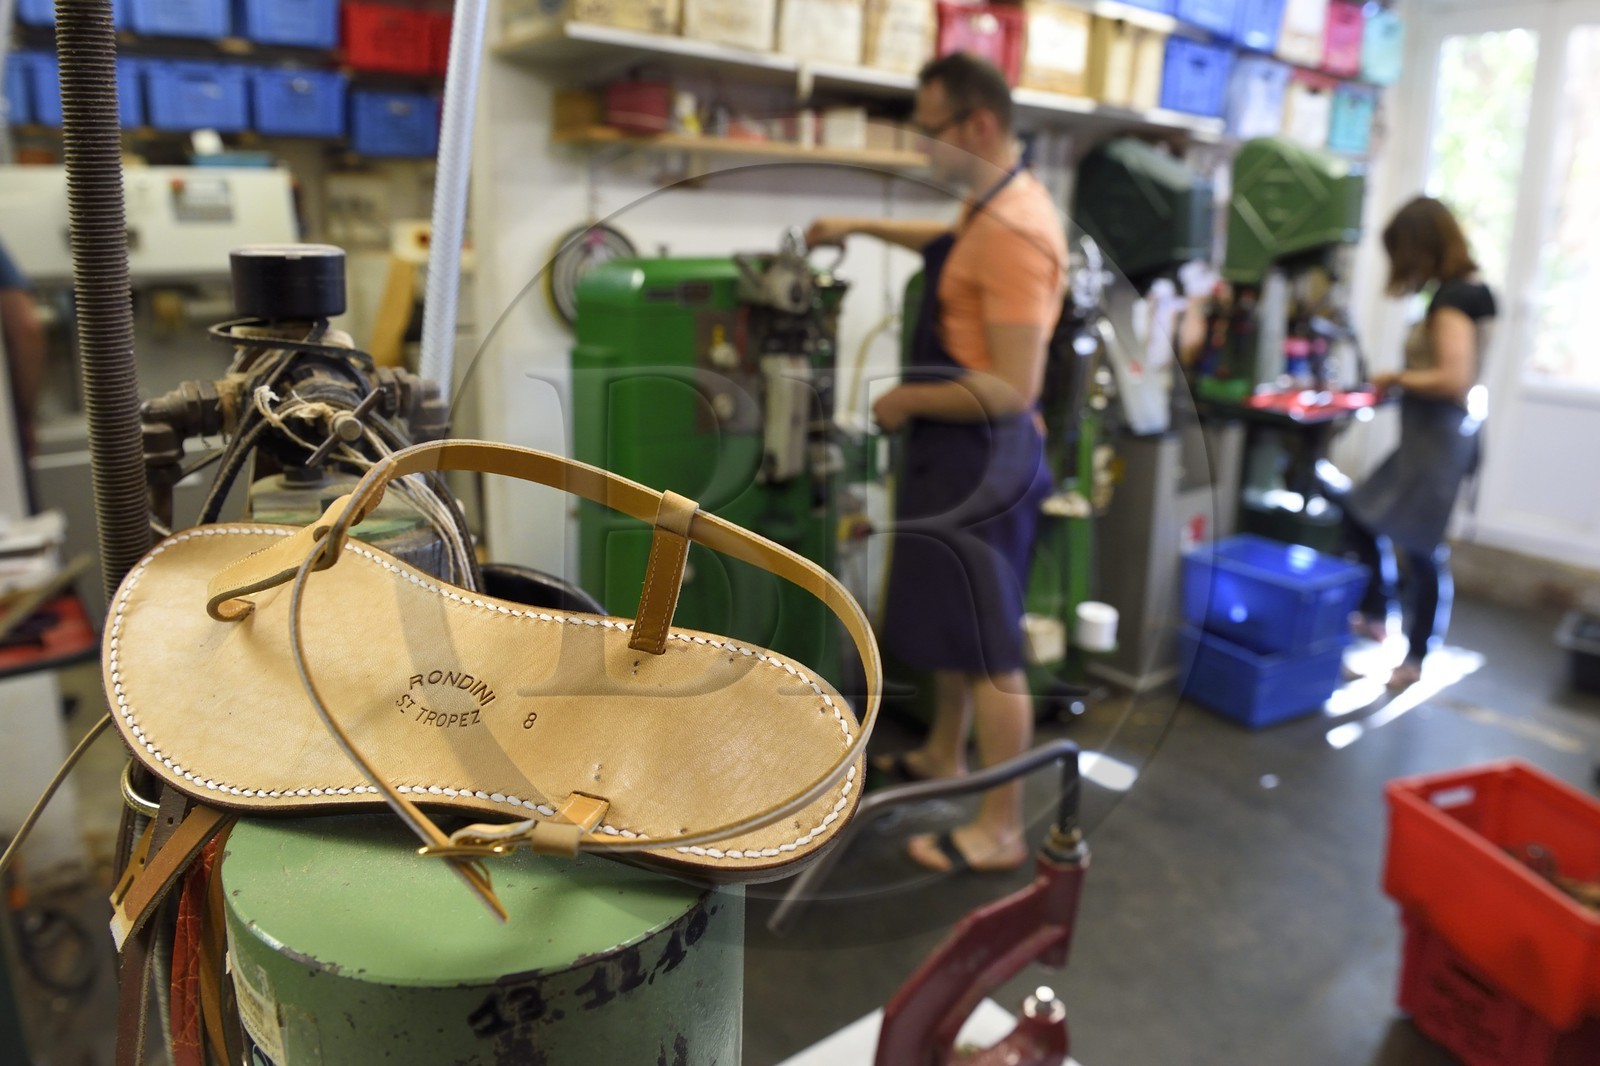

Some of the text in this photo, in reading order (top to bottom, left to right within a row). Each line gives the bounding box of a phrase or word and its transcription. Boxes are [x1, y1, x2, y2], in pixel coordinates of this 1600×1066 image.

[409, 670, 496, 706] RONDINI
[415, 709, 480, 728] TROPEZ
[523, 712, 538, 729] 8
